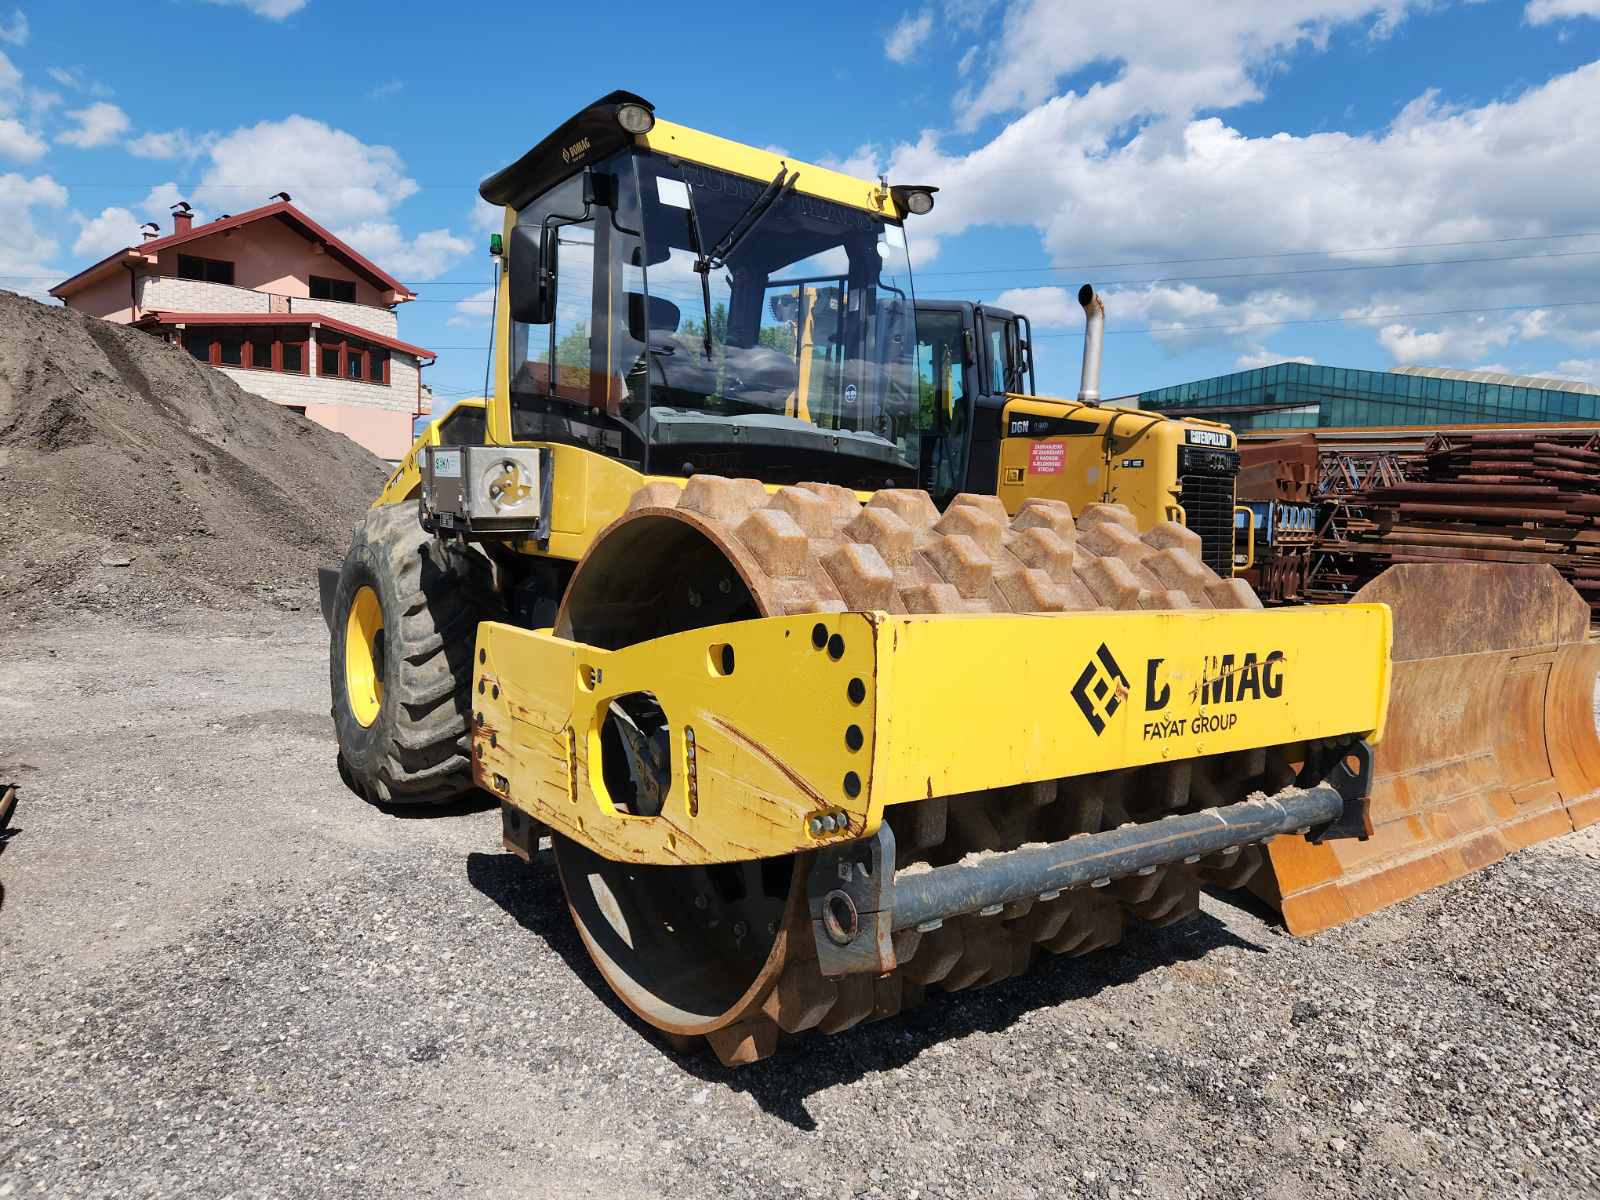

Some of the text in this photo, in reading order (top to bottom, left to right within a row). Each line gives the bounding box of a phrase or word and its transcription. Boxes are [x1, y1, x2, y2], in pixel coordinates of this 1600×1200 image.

[1190, 430, 1228, 447] CATERPILLAR
[1143, 713, 1238, 741] FAYAT GROUP
